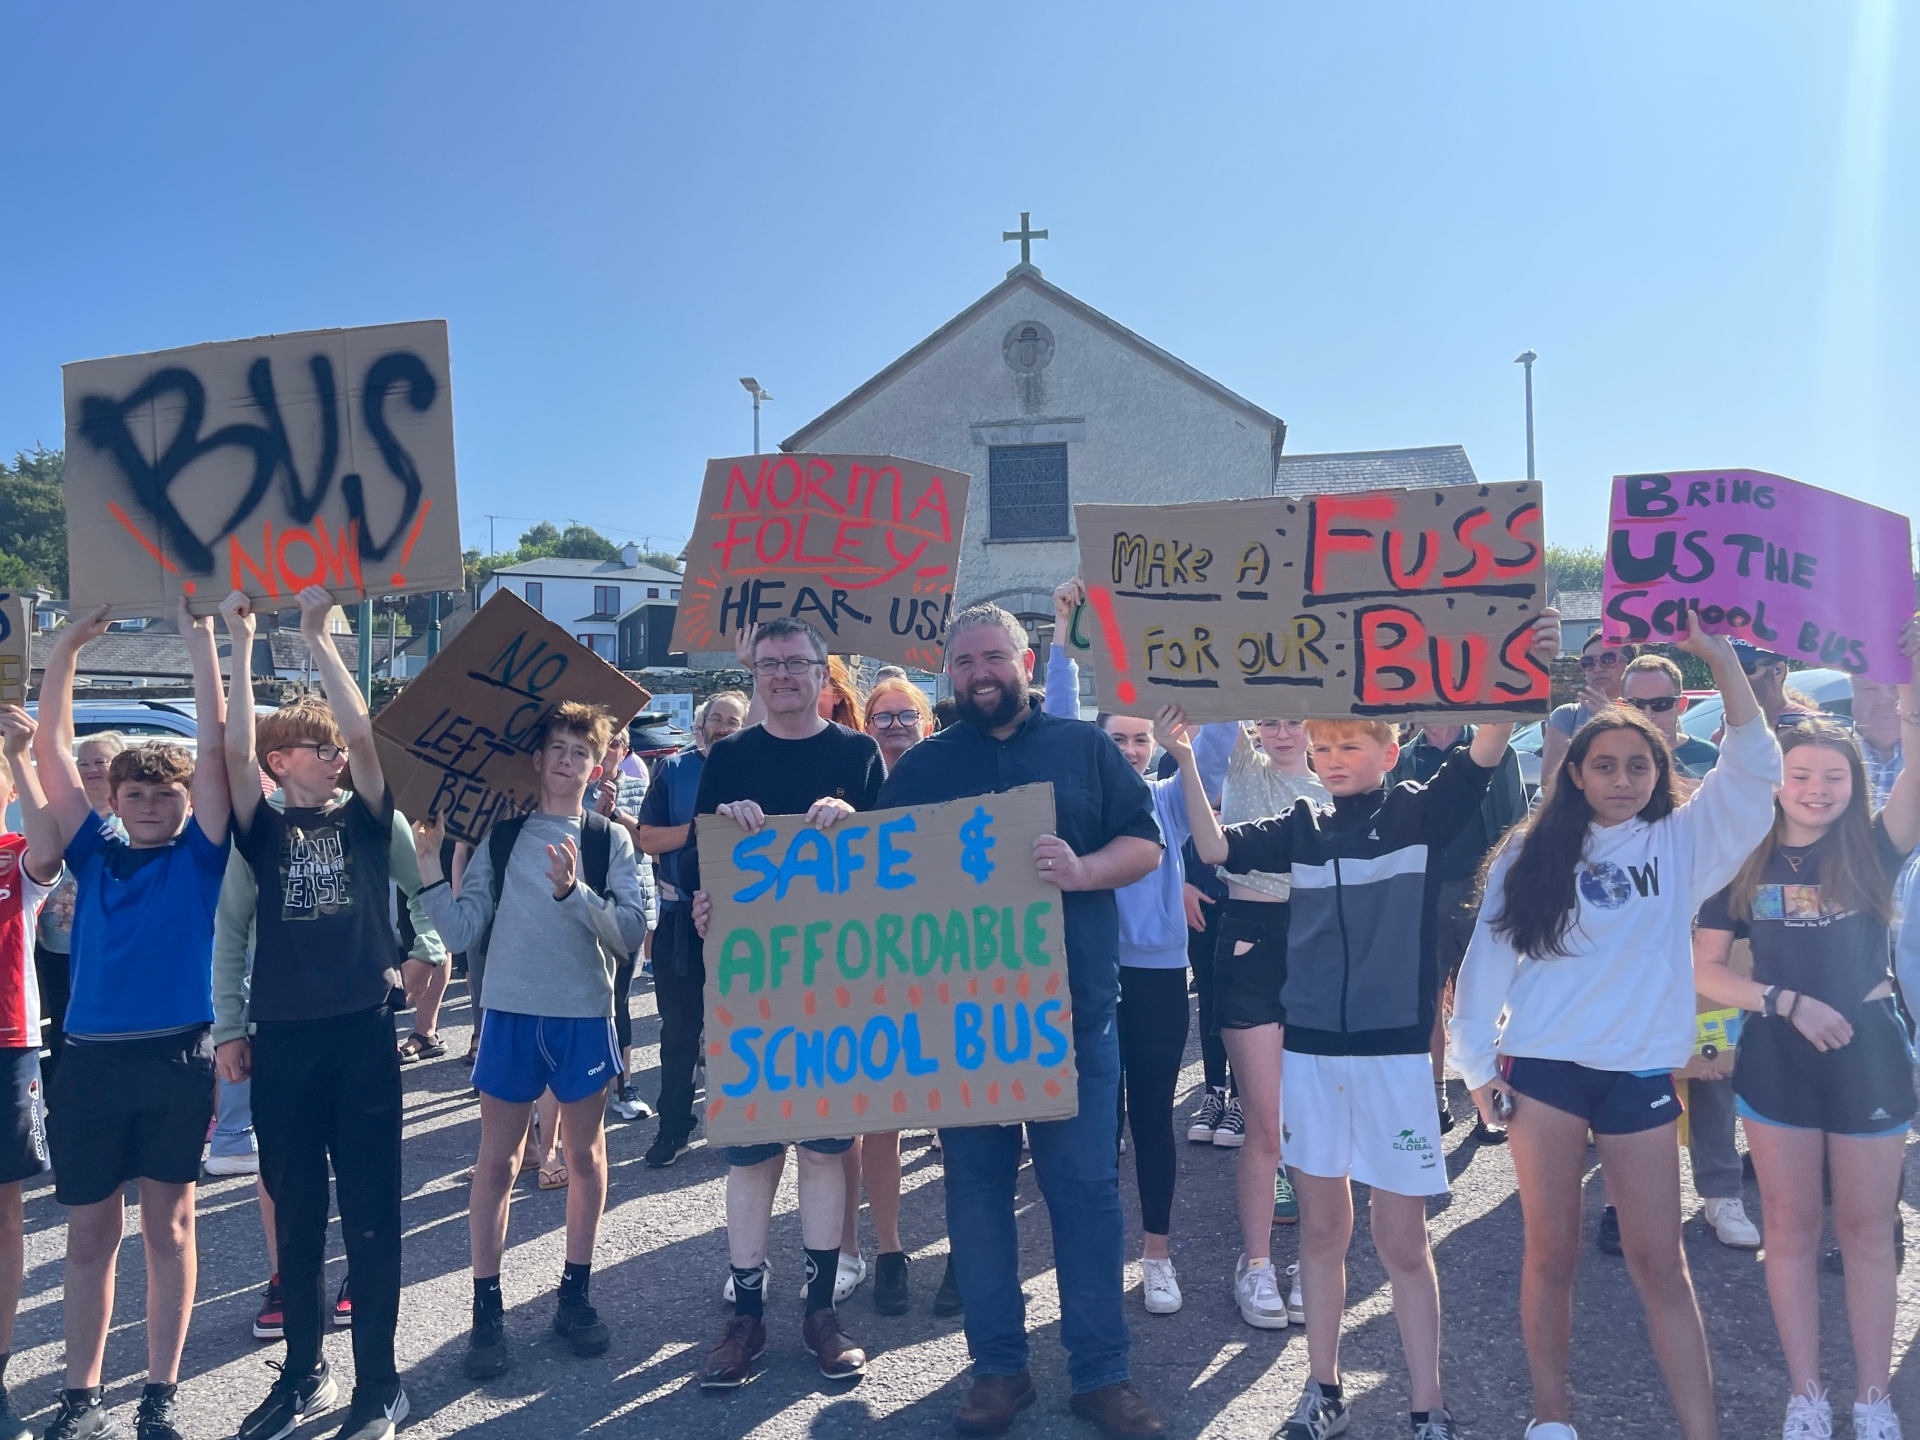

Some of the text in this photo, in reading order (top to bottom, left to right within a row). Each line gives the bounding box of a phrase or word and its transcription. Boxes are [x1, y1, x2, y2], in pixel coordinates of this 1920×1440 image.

[79, 350, 437, 575] BUS
[722, 457, 952, 543] NORMA
[1236, 541, 1270, 585] A
[1304, 494, 1543, 596] FUSS
[1611, 530, 1819, 590] US THE
[488, 629, 570, 694] NO
[1143, 624, 1219, 673] FOR
[1237, 612, 1330, 677] OUR
[1352, 603, 1550, 705] BUS
[1797, 621, 1870, 675] BUS
[413, 708, 516, 782] LEFT
[732, 813, 917, 904] SAFE
[717, 901, 1053, 998] AFFORDABLE
[722, 1000, 1069, 1098] SCHOOL BUS
[1392, 1143, 1433, 1152] GLOBAL
